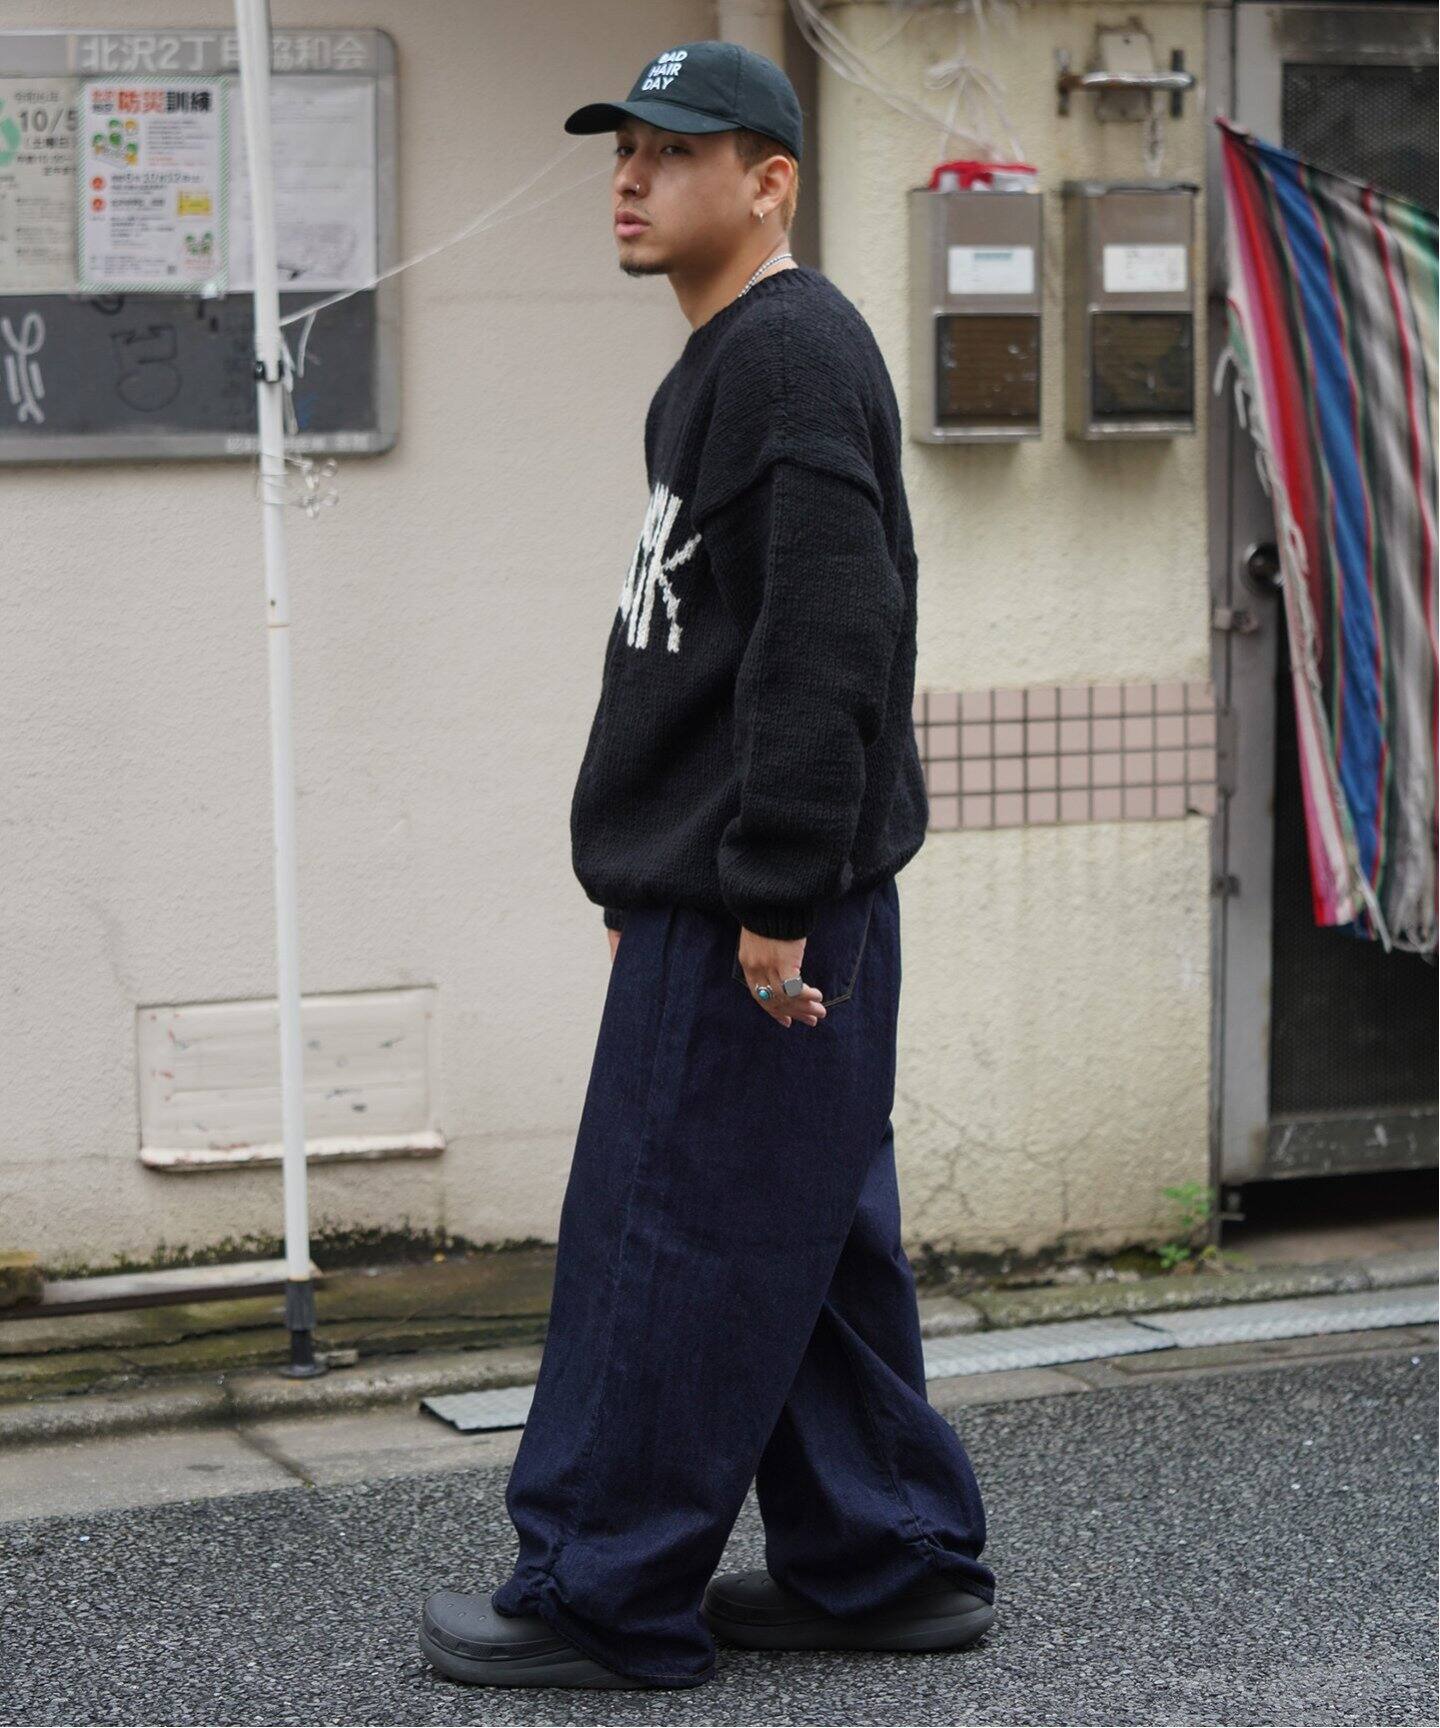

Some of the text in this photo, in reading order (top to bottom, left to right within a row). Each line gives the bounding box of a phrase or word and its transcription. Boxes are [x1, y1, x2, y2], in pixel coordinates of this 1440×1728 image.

[658, 50, 688, 64] BAD
[648, 63, 682, 77] HAIR
[641, 76, 674, 91] DAY
